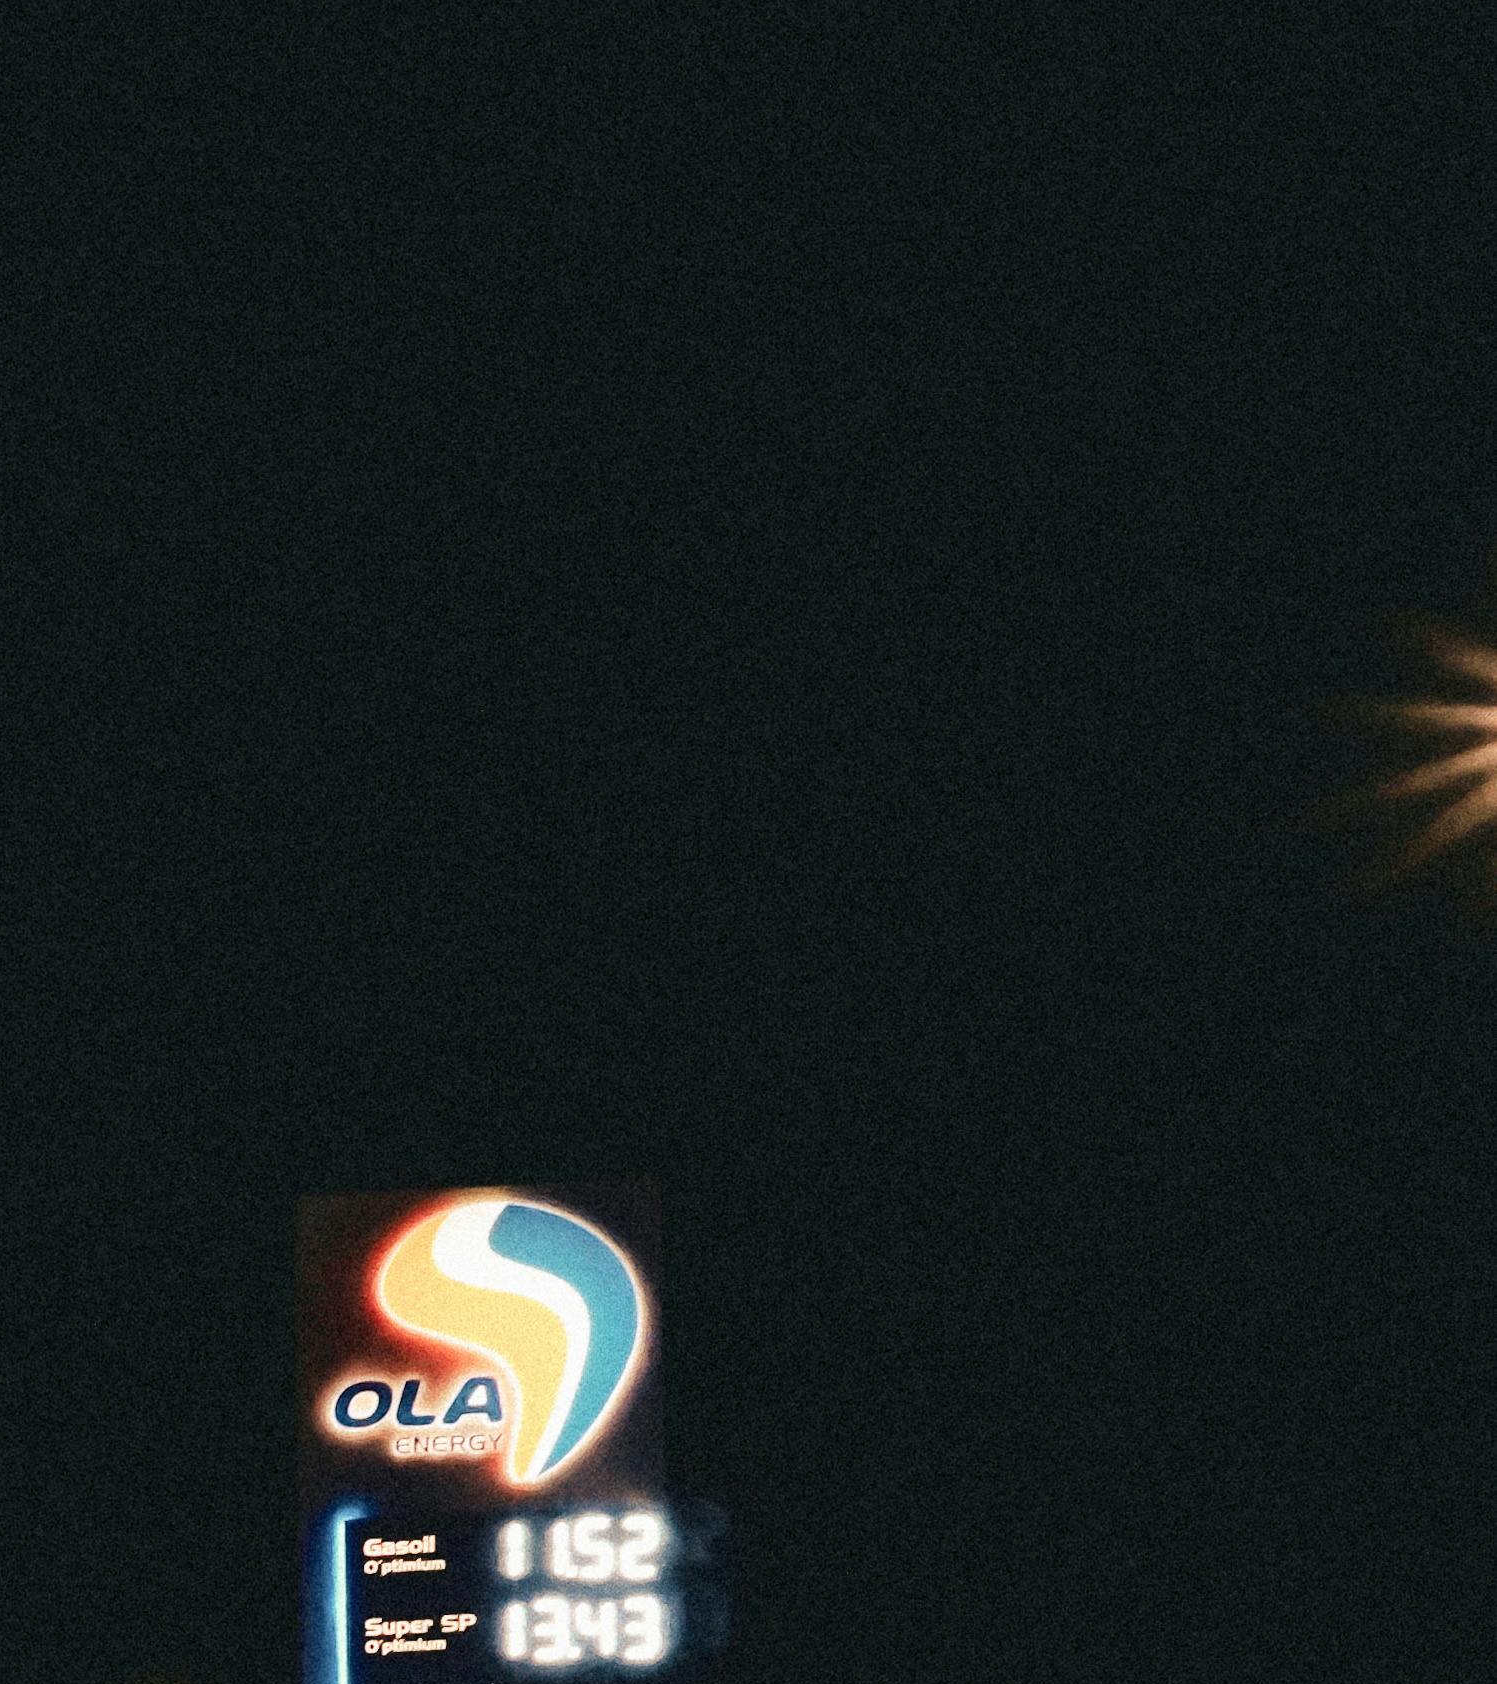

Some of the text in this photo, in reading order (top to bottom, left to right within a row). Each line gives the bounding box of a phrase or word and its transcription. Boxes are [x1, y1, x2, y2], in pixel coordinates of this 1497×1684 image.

[334, 1376, 504, 1428] OLA
[395, 1433, 504, 1455] ENERGY
[363, 1535, 437, 1557] Gasoil
[364, 1613, 477, 1638] Super SP
[502, 1594, 666, 1663] 13.43
